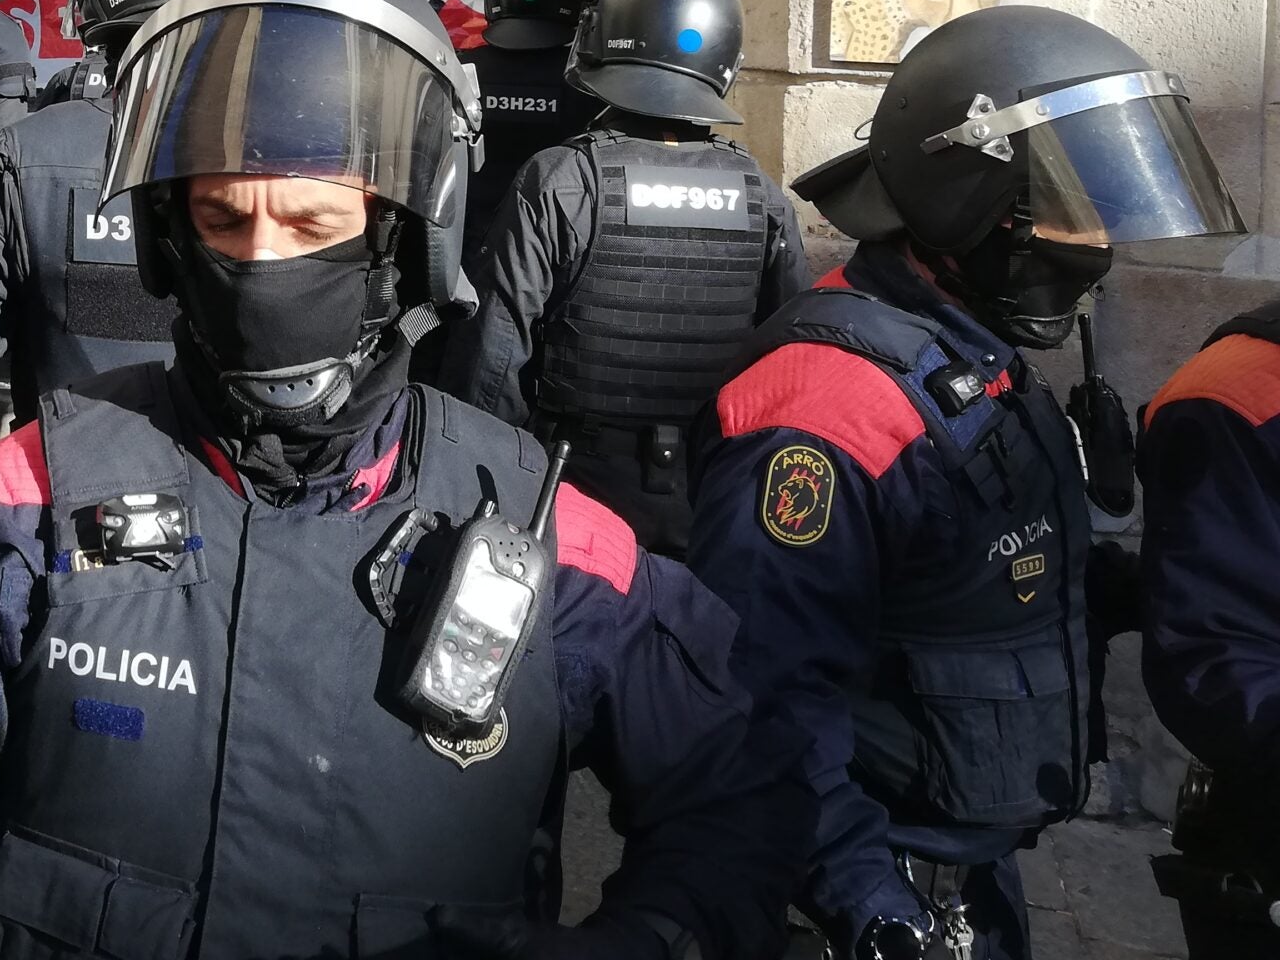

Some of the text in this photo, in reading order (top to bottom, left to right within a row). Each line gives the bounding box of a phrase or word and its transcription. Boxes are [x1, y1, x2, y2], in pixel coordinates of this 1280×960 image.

[486, 95, 558, 113] D3H231
[1016, 560, 1040, 575] 5599
[47, 637, 198, 696] POLICIA
